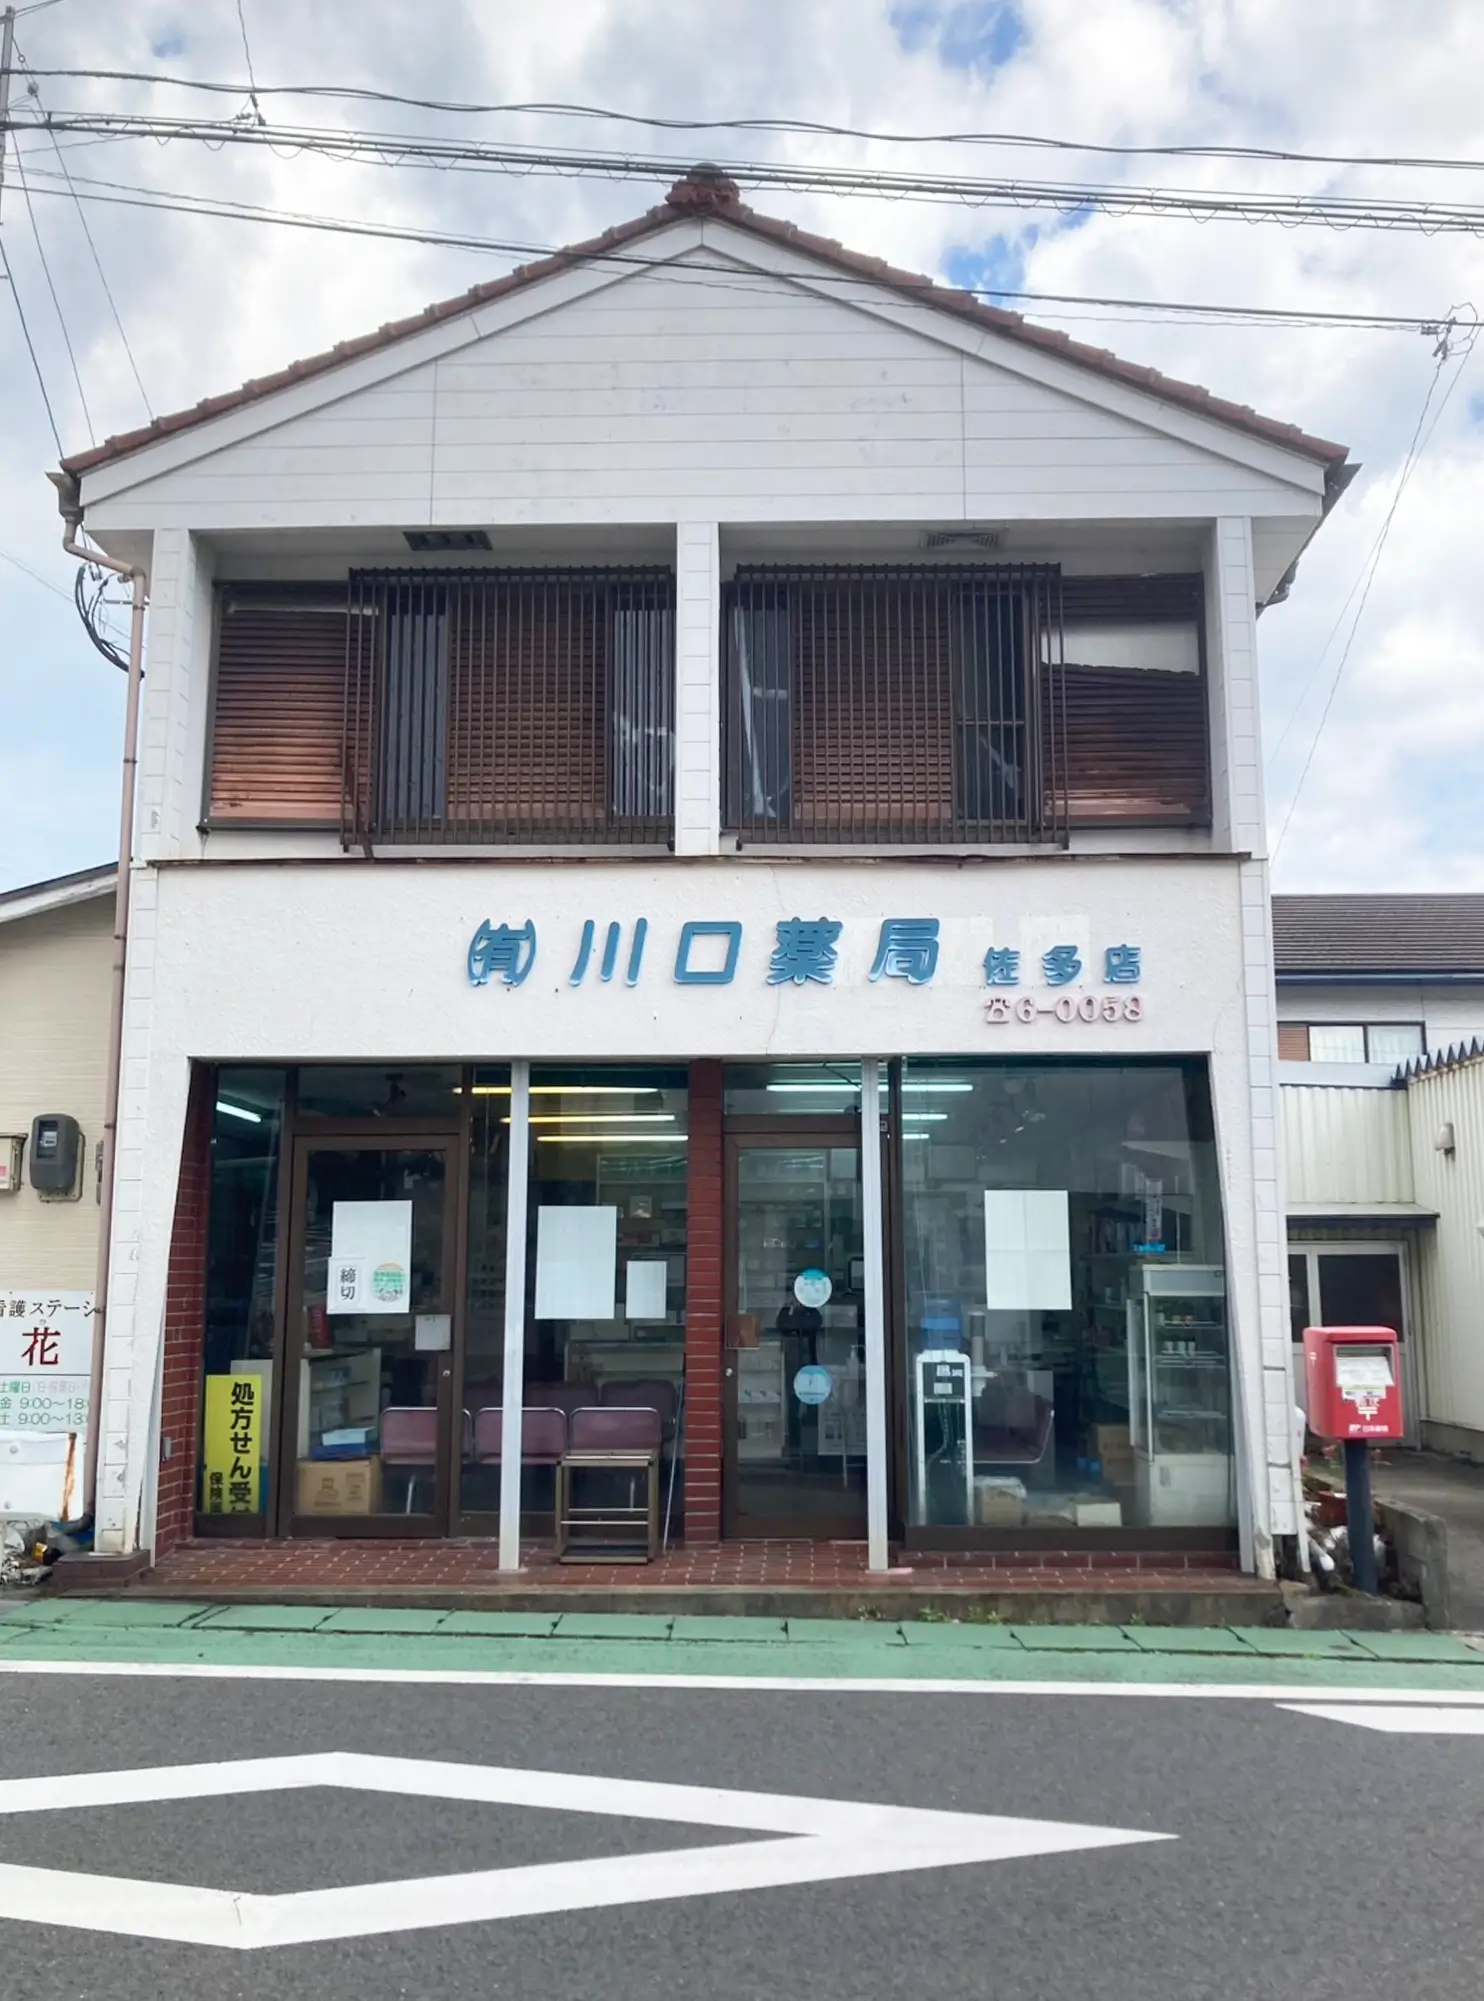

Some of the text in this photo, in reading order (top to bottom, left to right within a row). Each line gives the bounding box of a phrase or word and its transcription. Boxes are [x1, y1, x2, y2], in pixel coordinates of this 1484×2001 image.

[983, 944, 1141, 986] 佐多店
[340, 1268, 357, 1300] 締切
[21, 1326, 61, 1366] 花
